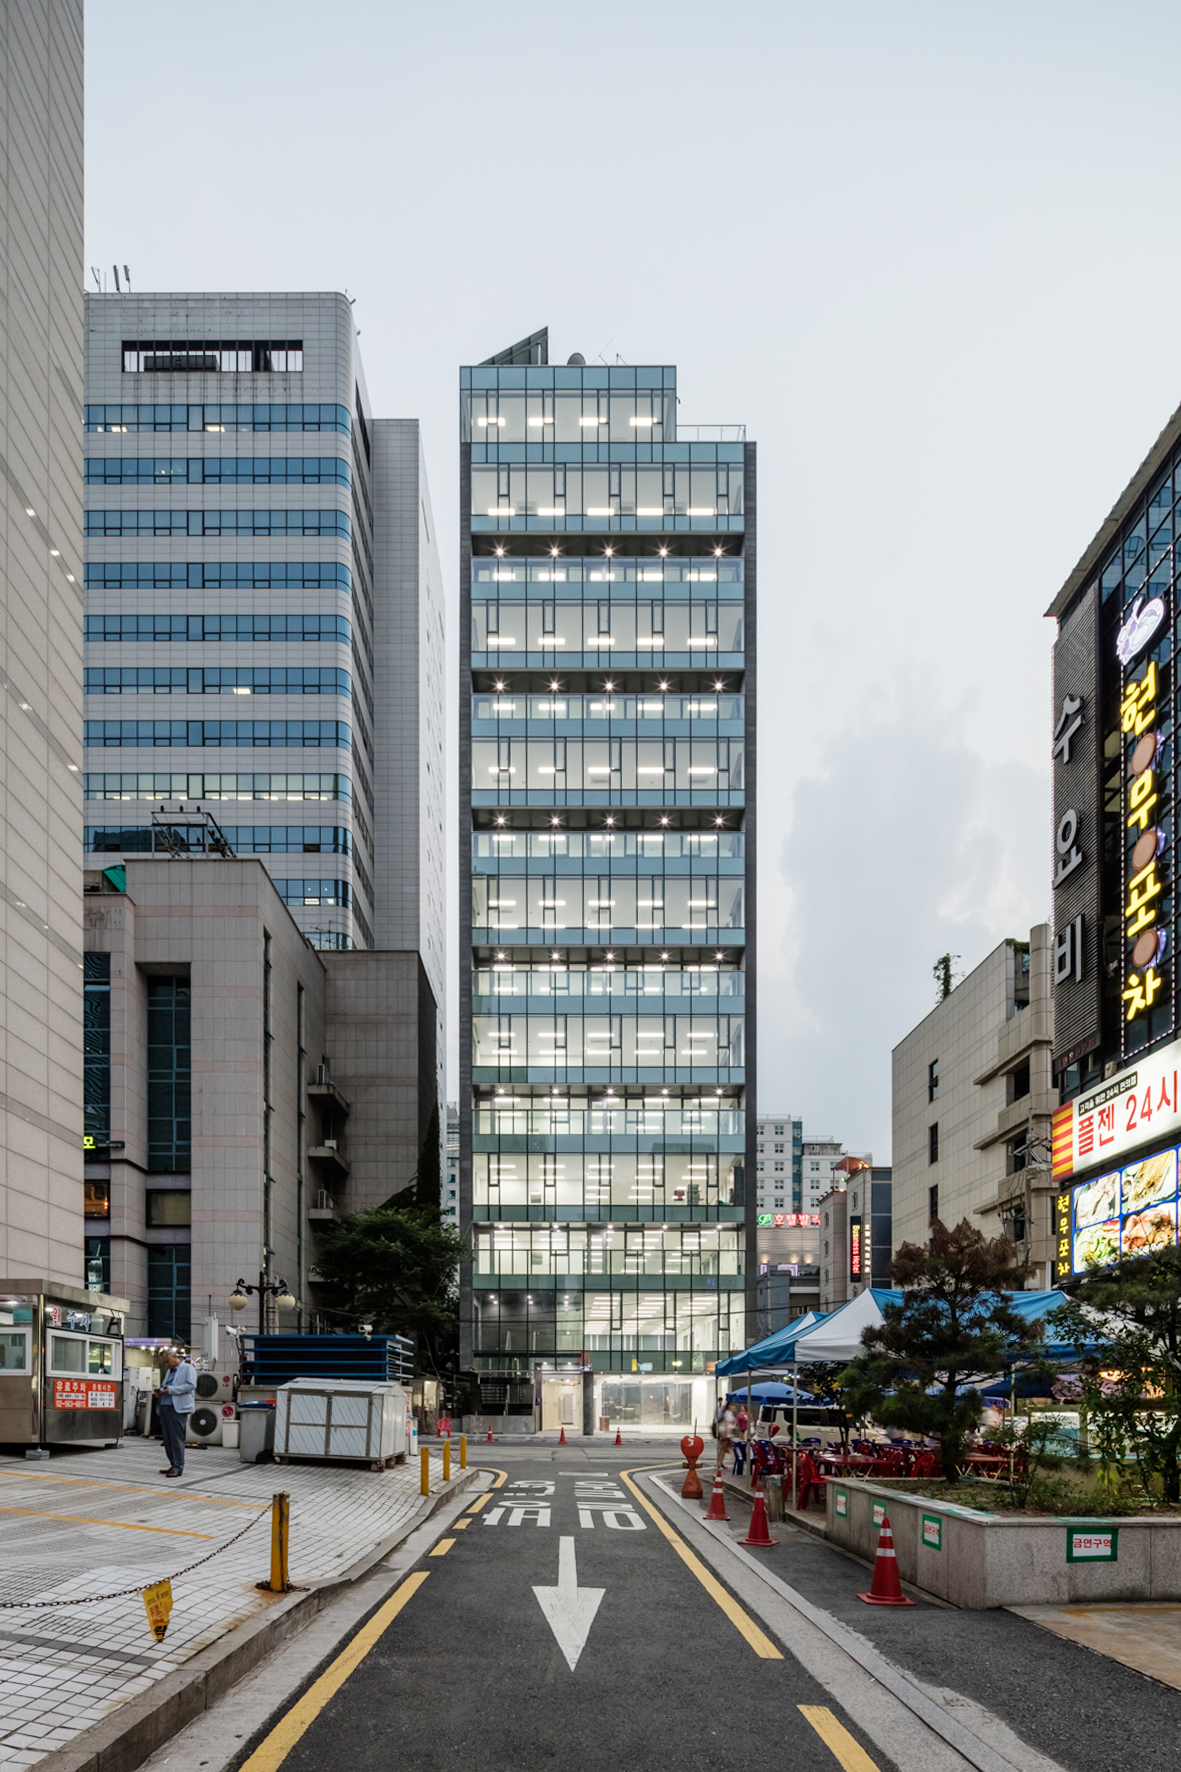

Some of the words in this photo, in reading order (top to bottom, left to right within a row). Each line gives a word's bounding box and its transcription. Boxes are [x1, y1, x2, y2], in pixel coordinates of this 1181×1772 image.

[1053, 693, 1084, 985] 수요비
[1120, 662, 1163, 1020] 현무포차
[1078, 1104, 1115, 1157] 플젠
[1126, 1069, 1178, 1132] 24시
[852, 1224, 861, 1255] Business
[1057, 1195, 1070, 1276] 현무포차
[852, 1255, 861, 1274] Hotel
[56, 1381, 87, 1392] 유료주차
[1073, 1537, 1112, 1549] 금연구역
